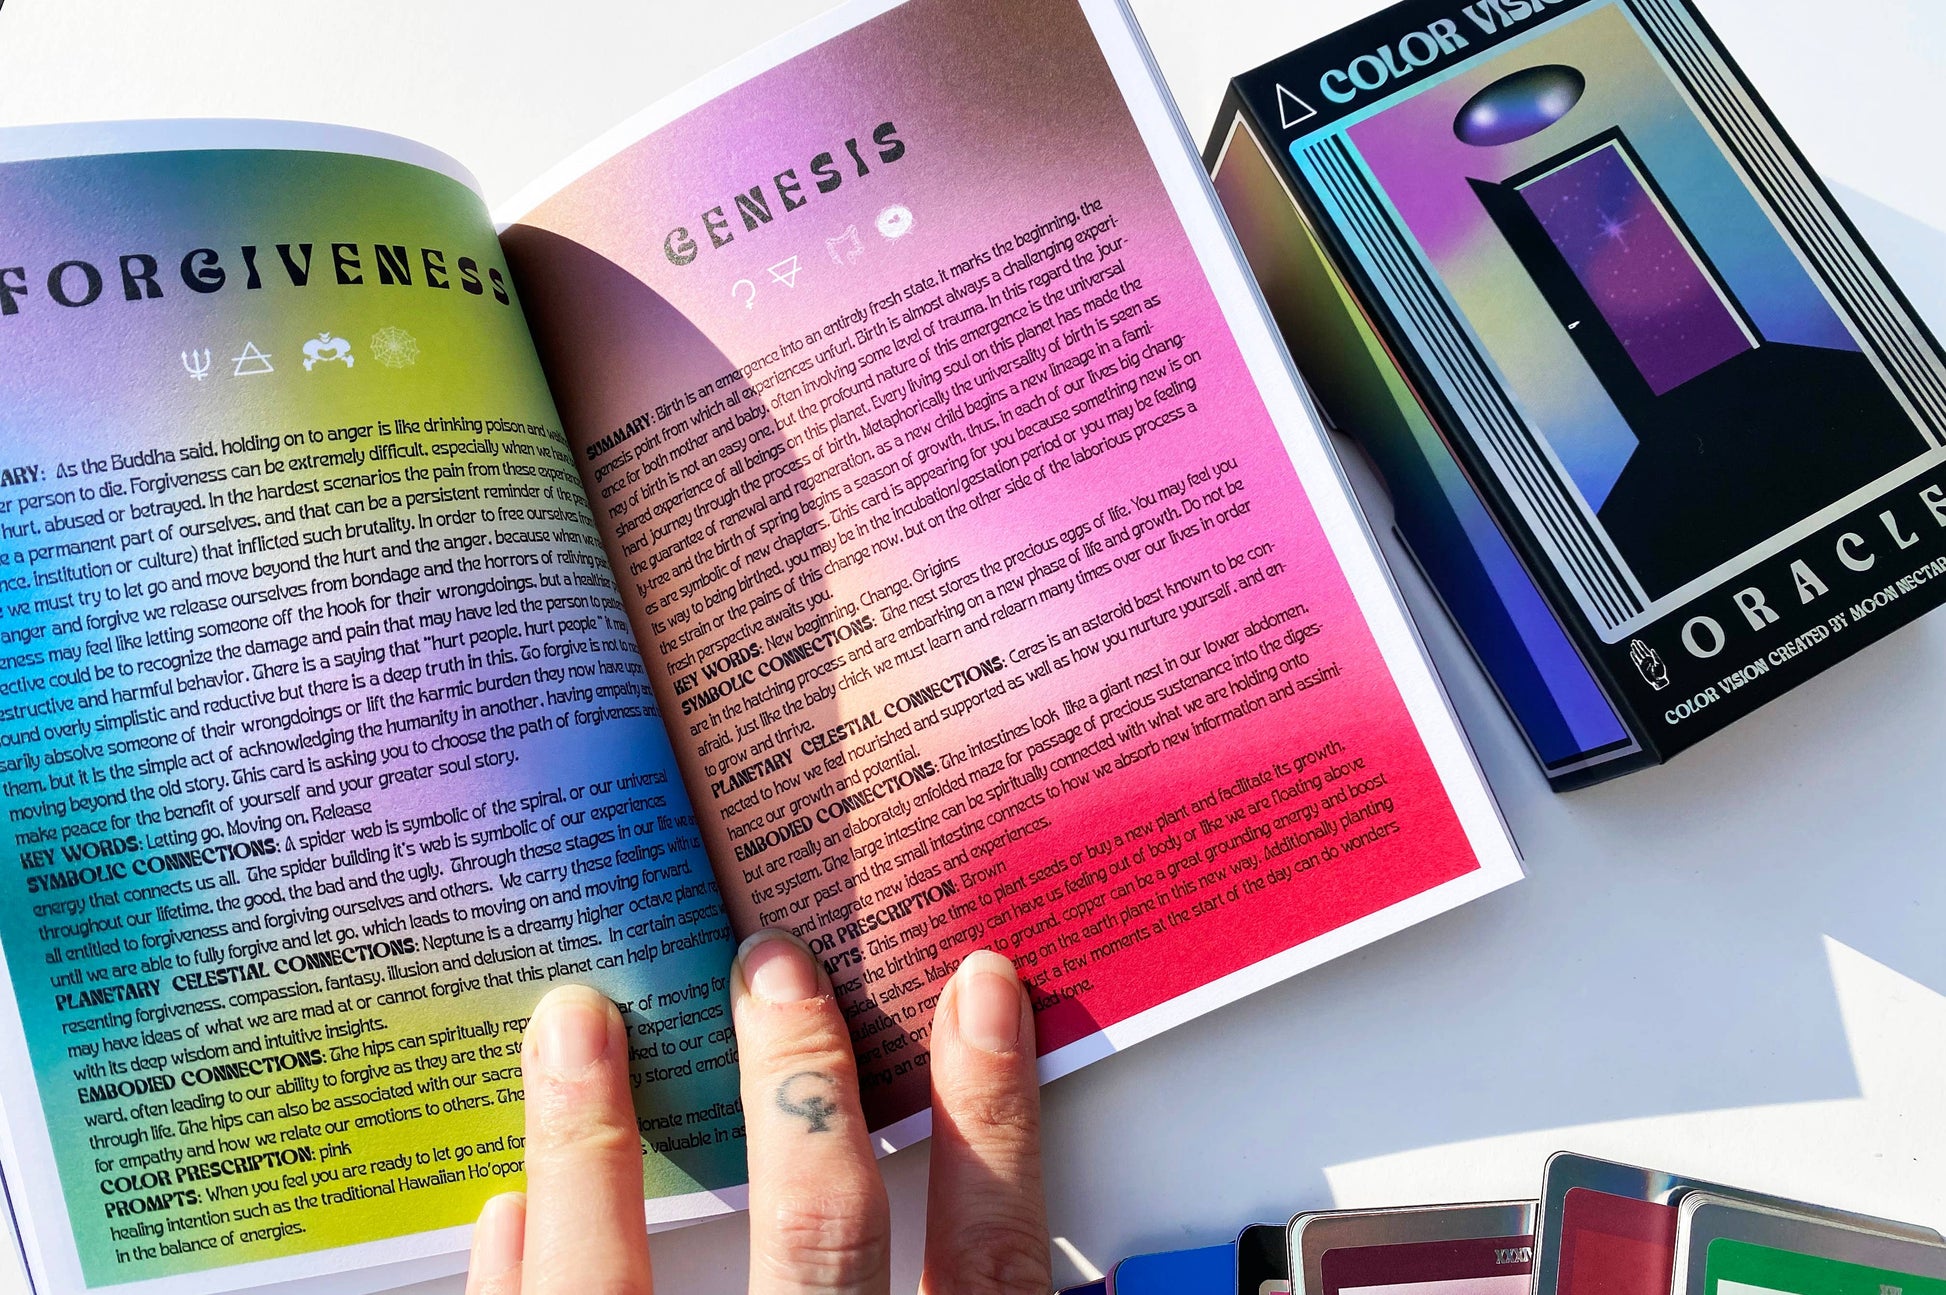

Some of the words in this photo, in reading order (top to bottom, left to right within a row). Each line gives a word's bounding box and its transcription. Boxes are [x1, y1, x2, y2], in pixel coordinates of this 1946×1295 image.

[1319, 18, 1470, 103] COLOR
[663, 121, 906, 266] GENESIS
[0, 243, 510, 315] FORGIVENESS
[586, 412, 656, 461] SUMMARY:
[655, 398, 685, 421] Birth
[684, 392, 697, 405] is
[698, 384, 714, 398] an
[715, 351, 780, 389] emergence
[779, 340, 804, 357] into
[805, 331, 822, 345] an
[823, 308, 868, 336] entirely
[869, 291, 903, 315] fresh
[938, 269, 949, 283] it
[950, 251, 991, 278] marks
[992, 241, 1014, 257] the
[1080, 199, 1103, 216] the
[57, 463, 78, 479] As
[81, 458, 108, 474] the
[111, 449, 176, 471] Buddha
[221, 435, 280, 455] holding
[284, 433, 304, 446] on
[308, 430, 324, 443] to
[328, 425, 373, 443] anger
[378, 421, 392, 436] is
[394, 419, 421, 434] like
[424, 416, 483, 434] drinking
[485, 418, 525, 434] poison
[527, 423, 546, 438] and
[33, 562, 112, 587] institution
[116, 560, 132, 574] or
[138, 545, 198, 570] culture)
[202, 542, 234, 560] that
[237, 531, 299, 555] inflicted
[303, 525, 342, 545] such
[418, 514, 433, 529] In
[436, 509, 477, 526] order
[481, 509, 495, 522] to
[498, 507, 524, 521] free
[527, 507, 578, 523] ourselves
[681, 670, 756, 716] SYMBOLIC
[758, 615, 877, 677] CONNECTIONS:
[880, 603, 908, 621] The
[909, 589, 938, 610] nest
[938, 572, 980, 597] stores
[980, 561, 1002, 578] the
[1003, 537, 1059, 572] precious
[1060, 522, 1092, 544] eggs
[1093, 512, 1106, 528] of
[1107, 505, 1131, 522] life.
[1130, 493, 1157, 511] You
[1157, 480, 1186, 501] may
[1187, 466, 1211, 487] feel
[1212, 458, 1238, 480] you
[673, 671, 699, 696] KEY
[701, 642, 764, 680] WORDS:
[765, 630, 794, 651] New
[913, 556, 960, 583] Origins
[711, 748, 793, 799] PLANETARY
[801, 711, 882, 756] CELESTIAL
[884, 656, 1008, 718] CONNECTIONS:
[1009, 641, 1047, 663] Ceres
[1046, 634, 1061, 648] is
[1062, 626, 1081, 641] an
[1081, 599, 1134, 633] asteroid
[1133, 587, 1164, 610] best
[1163, 569, 1212, 596] known
[1212, 563, 1226, 575] to
[1226, 554, 1246, 570] be
[1664, 686, 1721, 725] COLOR
[1717, 657, 1770, 694] VISION
[1768, 624, 1830, 666] CREATED
[1830, 612, 1849, 633] BY
[1849, 585, 1899, 622] MOON
[734, 816, 813, 862] EMBODIED
[816, 761, 940, 824] CONNECTIONS:
[939, 751, 968, 769] The
[967, 723, 1031, 758] intestines
[1029, 709, 1060, 730] look
[1062, 698, 1087, 716] like
[1088, 694, 1099, 705] a
[1100, 676, 1133, 704] giant
[1134, 663, 1164, 685] nest
[1163, 658, 1179, 672] in
[1179, 647, 1201, 665] our
[1203, 631, 1239, 655] lower
[20, 848, 54, 870] KEY
[60, 835, 143, 863] WORDS:
[146, 830, 197, 849] Letting
[226, 815, 282, 836] Moving
[311, 802, 372, 822] Release
[27, 862, 127, 893] SYMBOLIC
[132, 838, 281, 875] CONNECTIONS:
[285, 836, 296, 852] A
[299, 829, 346, 852] spider
[351, 822, 383, 840] web
[385, 819, 399, 835] is
[402, 807, 469, 835] symbolic
[472, 802, 487, 819] of
[492, 799, 517, 815] the
[569, 786, 585, 800] or
[589, 781, 613, 796] our
[616, 768, 668, 790] universal
[55, 979, 160, 1011] PLANETARY
[172, 962, 270, 991] CELESTIAL
[274, 937, 420, 974] CONNECTIONS:
[422, 931, 485, 951] Neptune
[486, 925, 501, 940] is
[504, 926, 514, 937] a
[517, 914, 573, 935] dreamy
[576, 903, 625, 925] higher
[629, 892, 673, 912] octave
[675, 881, 708, 905] planet
[836, 879, 960, 944] PRESCRIPTION:
[960, 861, 1007, 889] Brown
[1052, 967, 1063, 978] a
[1063, 954, 1088, 974] few
[1090, 927, 1151, 963] moments
[1149, 918, 1167, 937] at
[1167, 910, 1191, 927] the
[1191, 893, 1225, 917] start
[1226, 884, 1240, 902] of
[1242, 877, 1266, 894] the
[1264, 866, 1292, 885] day
[1294, 855, 1321, 873] can
[1321, 846, 1339, 862] do
[1340, 821, 1400, 853] wonders
[77, 1074, 176, 1104] EMBODIED
[181, 1049, 327, 1086] CONNECTIONS:
[329, 1046, 360, 1062] The
[362, 1040, 395, 1058] hips
[398, 1036, 426, 1050] can
[429, 1020, 499, 1047] spiritually
[100, 1170, 172, 1195] COLOR
[175, 1146, 316, 1183] PRESCRIPTION:
[319, 1141, 352, 1163] pink
[115, 1249, 131, 1263] in
[133, 1246, 157, 1260] the
[159, 1237, 218, 1256] balance
[220, 1230, 234, 1246] of
[240, 1222, 306, 1242] energies.
